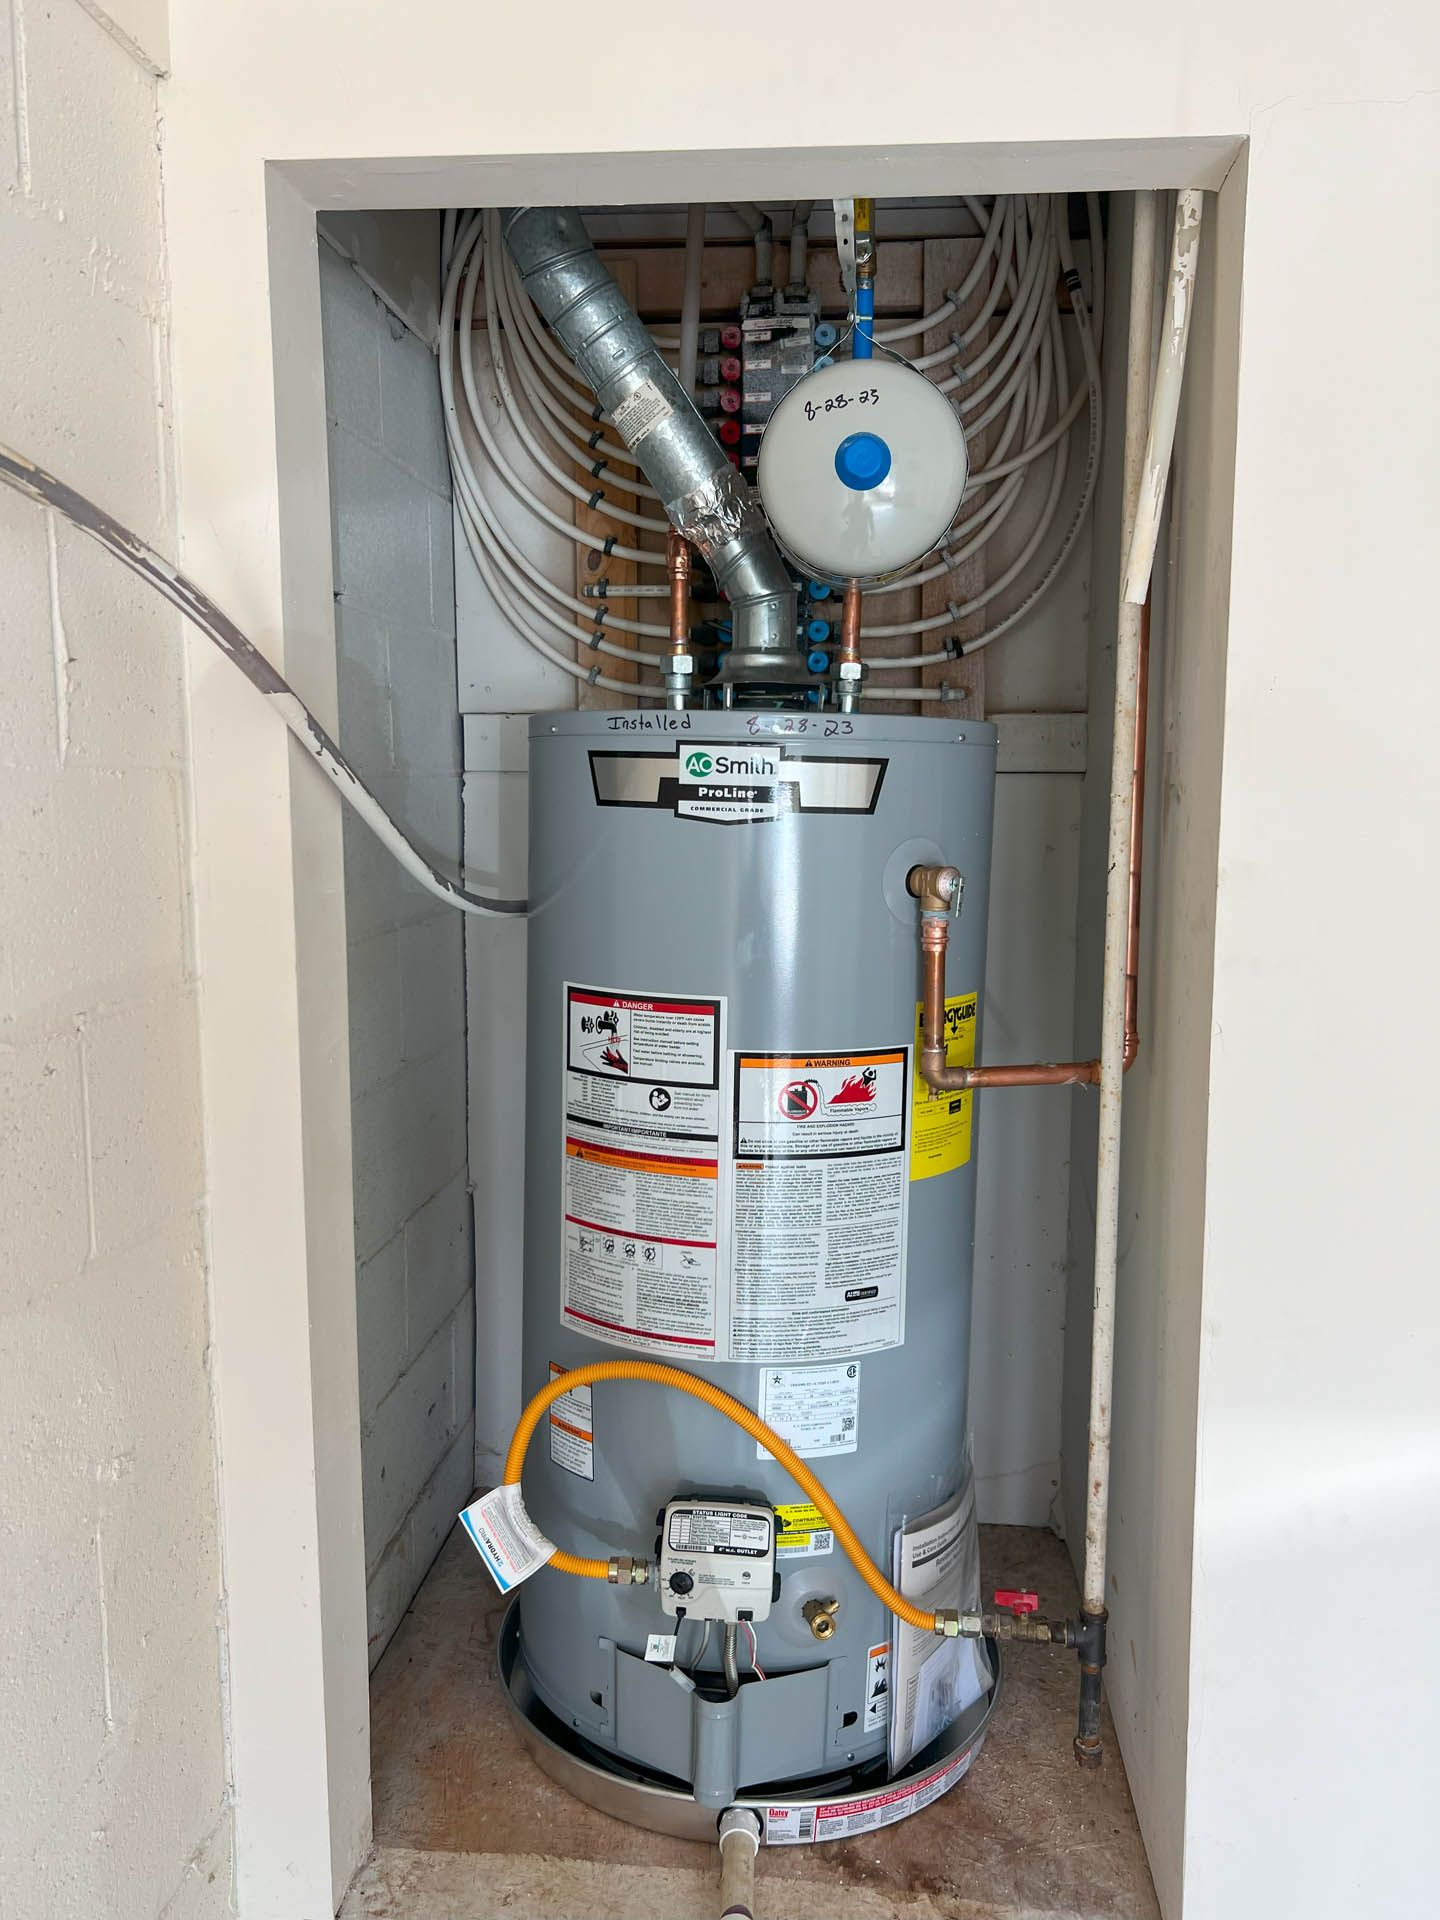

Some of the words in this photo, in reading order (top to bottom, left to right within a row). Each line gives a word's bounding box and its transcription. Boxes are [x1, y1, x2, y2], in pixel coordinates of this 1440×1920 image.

[607, 714, 691, 730] Installed
[715, 755, 774, 776] Smith
[698, 787, 754, 799] ProLine
[622, 1001, 653, 1010] DANGER
[769, 1808, 788, 1817] Oatey
